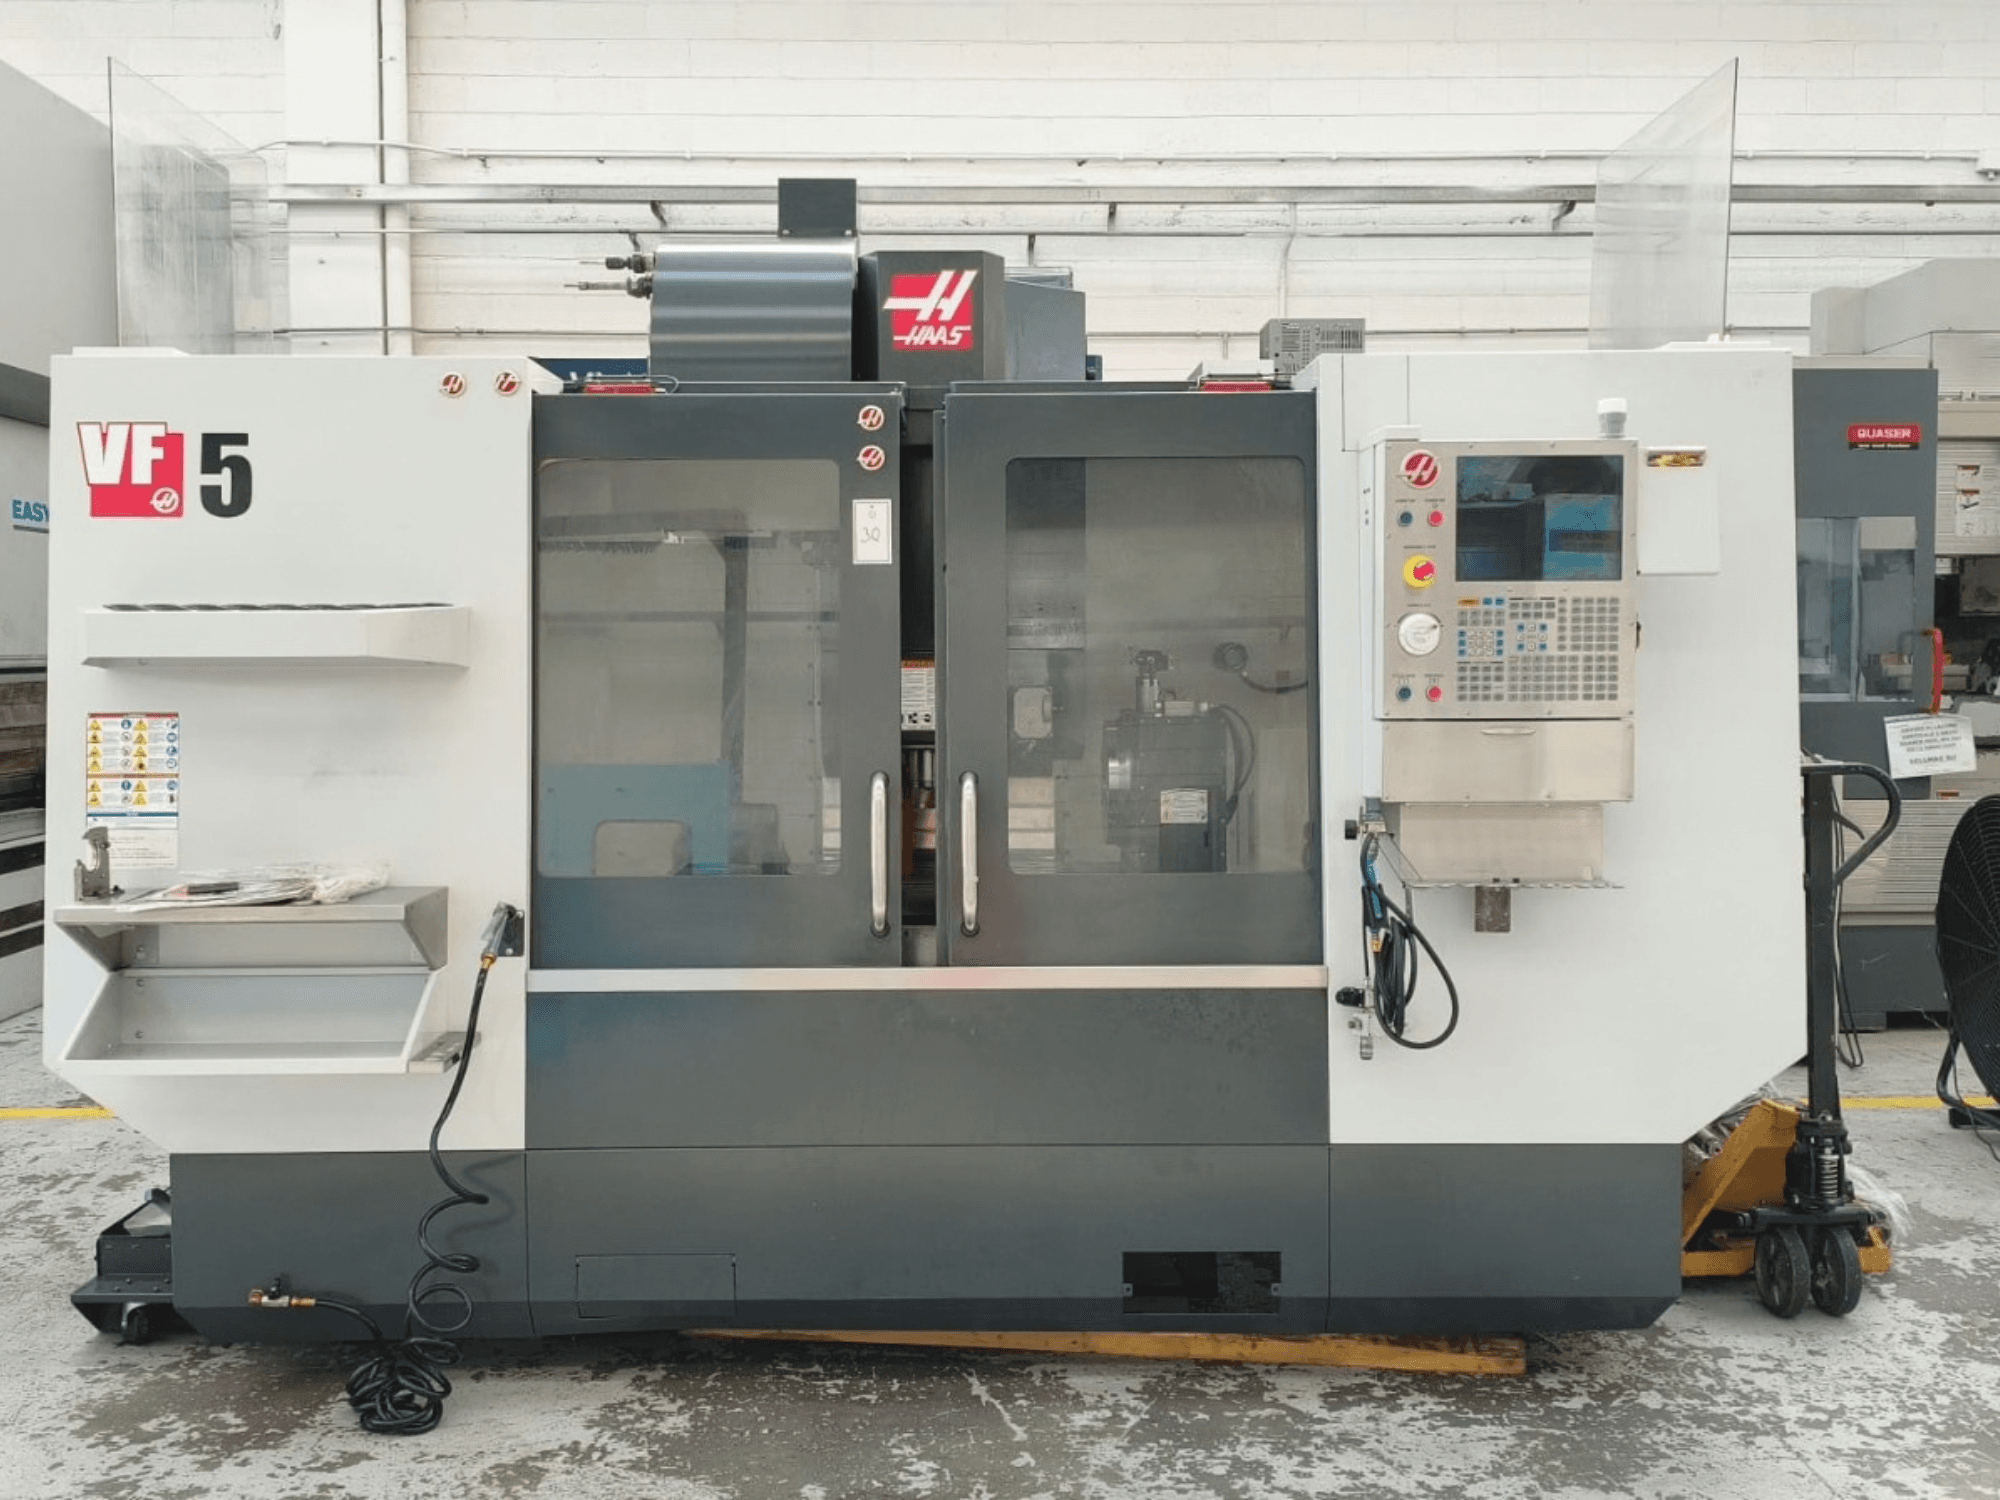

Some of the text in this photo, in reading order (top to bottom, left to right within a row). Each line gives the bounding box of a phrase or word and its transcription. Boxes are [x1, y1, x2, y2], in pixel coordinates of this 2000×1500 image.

[893, 325, 971, 345] HAAS
[1857, 428, 1911, 438] QUASER
[77, 422, 252, 518] VF 5
